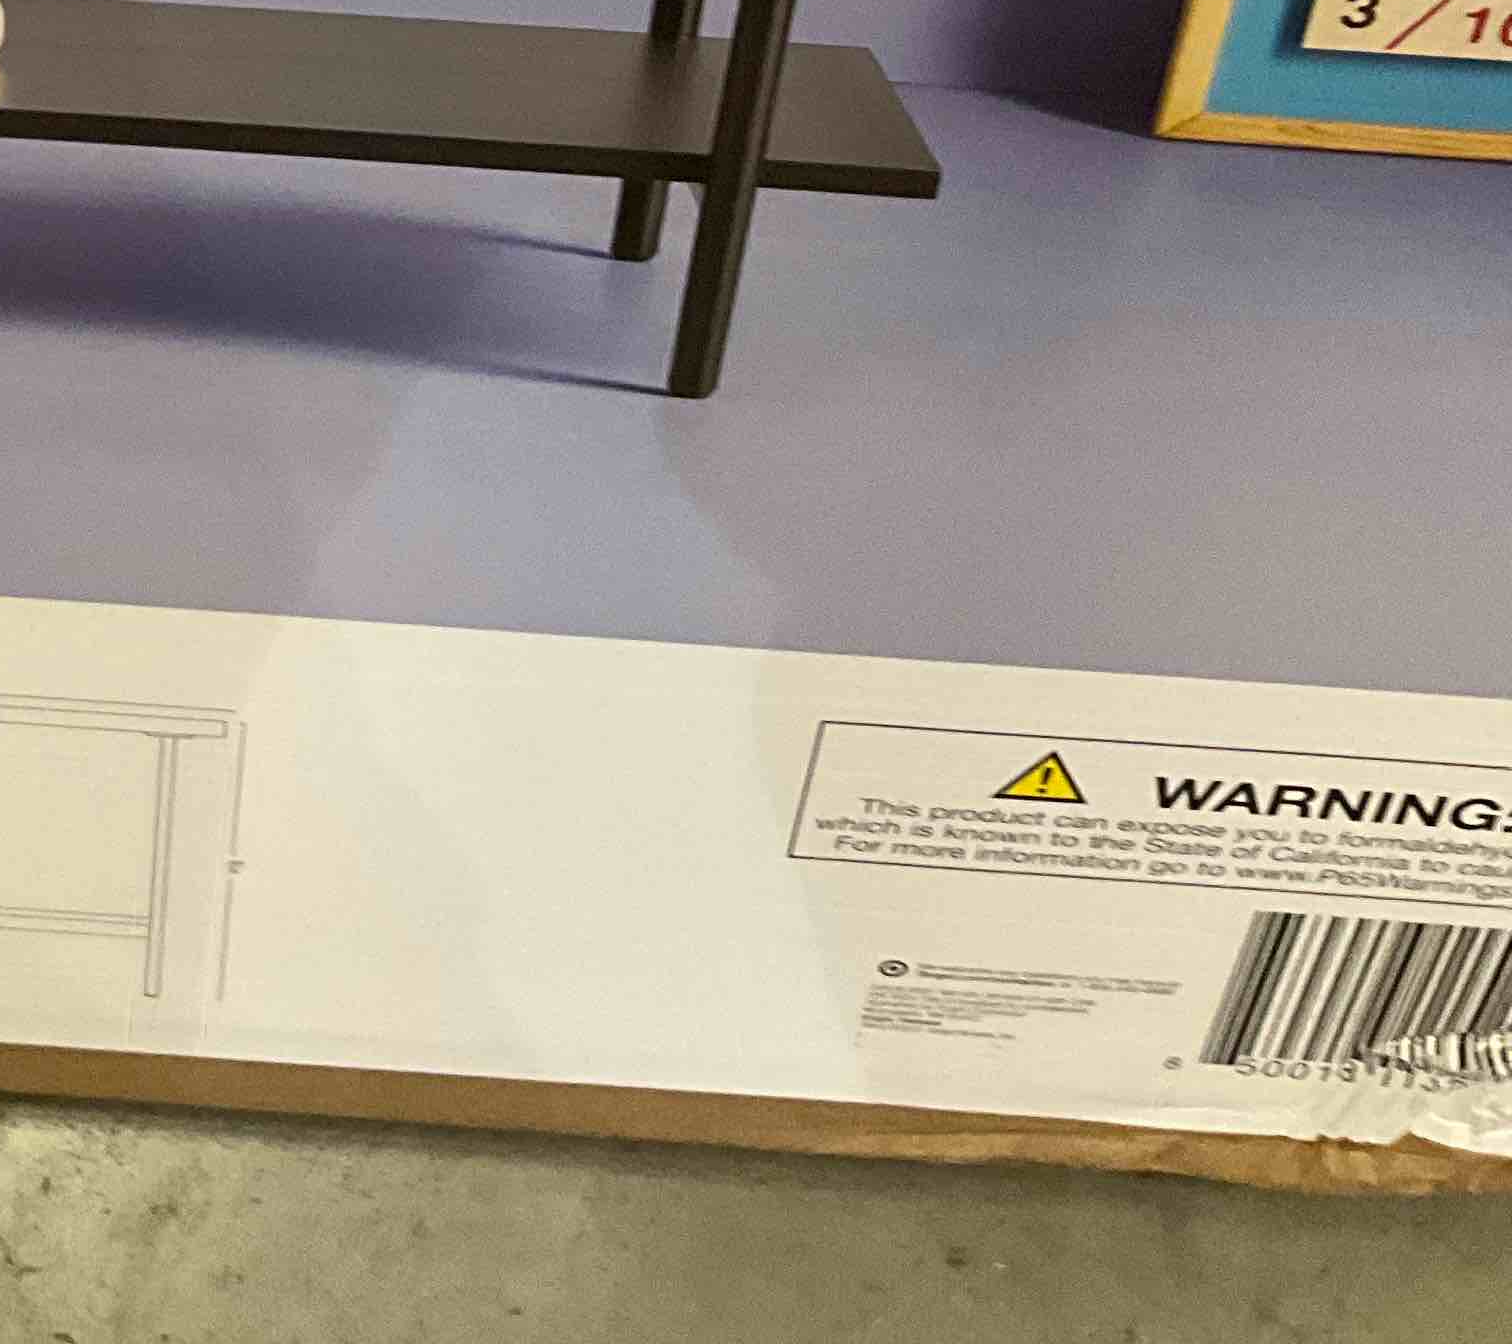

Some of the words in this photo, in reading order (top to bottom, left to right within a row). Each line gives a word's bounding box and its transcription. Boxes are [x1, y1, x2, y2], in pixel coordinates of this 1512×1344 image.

[815, 815, 901, 837] which
[910, 821, 935, 838] is
[942, 824, 1041, 847] known
[1050, 831, 1080, 849] to
[1088, 834, 1134, 852] the
[1144, 836, 1223, 858] State
[1230, 844, 1263, 860] of
[1268, 845, 1411, 872] California
[1419, 857, 1451, 873] to
[860, 797, 920, 818] This
[928, 806, 1046, 829] product
[1055, 813, 1108, 830] can
[1117, 817, 1226, 839] expose
[1233, 826, 1290, 844] you
[1298, 829, 1329, 845] to
[833, 833, 885, 853] For
[890, 840, 966, 860] more
[974, 845, 1141, 872] information
[1147, 859, 1188, 877] go
[1196, 862, 1227, 878] to
